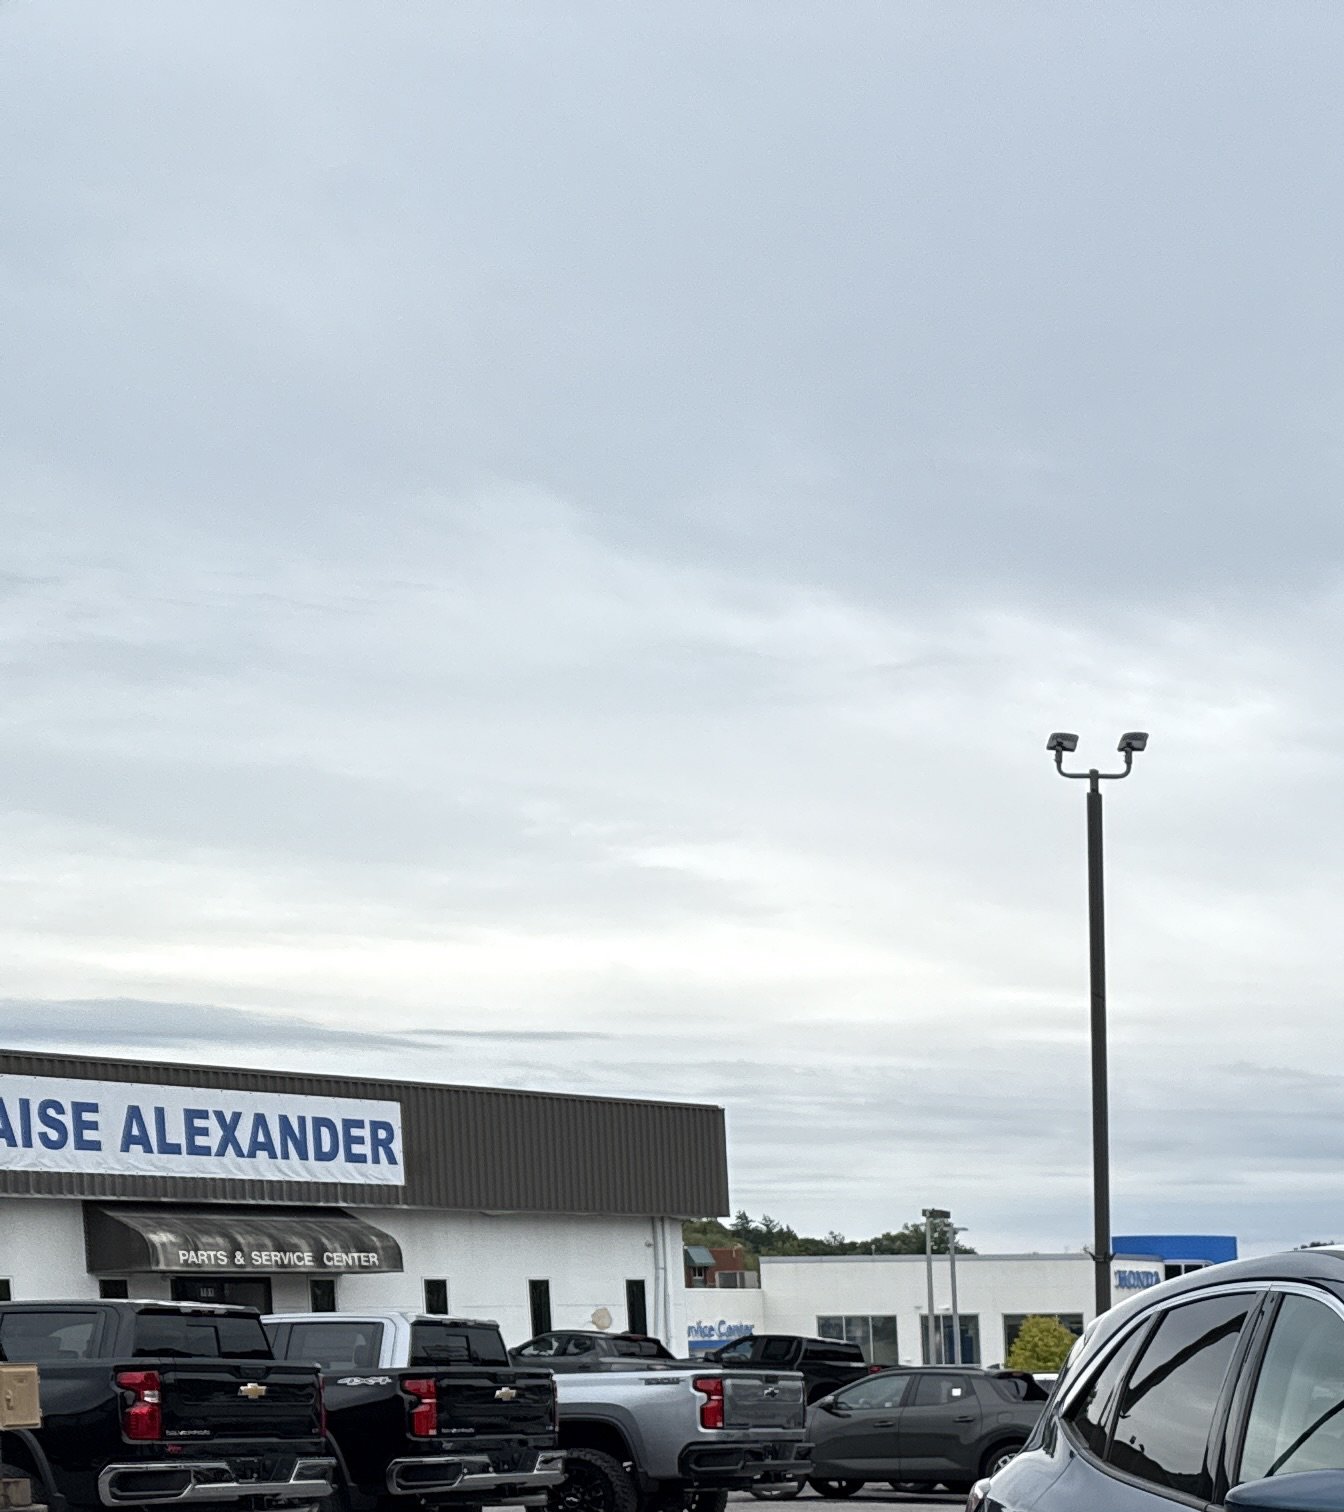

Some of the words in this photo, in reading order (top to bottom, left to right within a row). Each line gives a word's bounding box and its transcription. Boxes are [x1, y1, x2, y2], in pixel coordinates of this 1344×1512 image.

[119, 1104, 399, 1166] ALEXANDER
[178, 1250, 228, 1265] PARTS
[234, 1251, 246, 1265] &
[251, 1251, 315, 1266] SERVICE
[323, 1252, 379, 1266] CENTER
